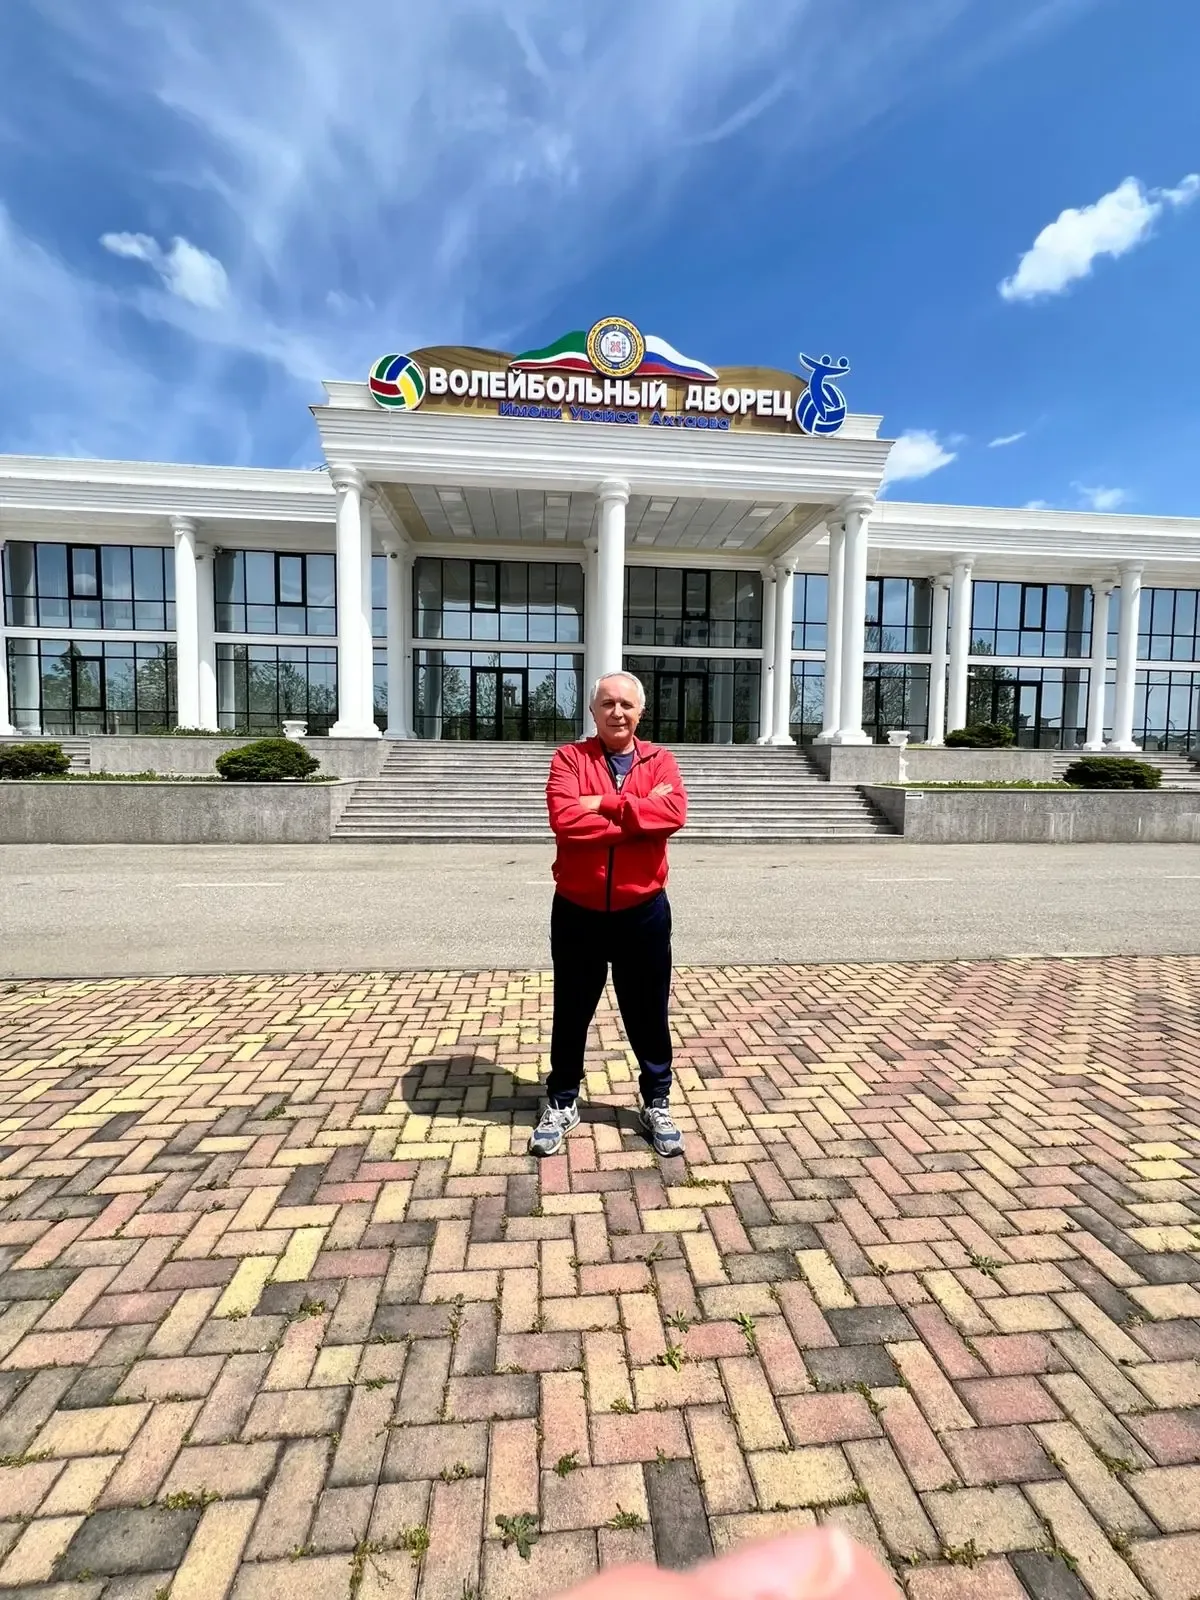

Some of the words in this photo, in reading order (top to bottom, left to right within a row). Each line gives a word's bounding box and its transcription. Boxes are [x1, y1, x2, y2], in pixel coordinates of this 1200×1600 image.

[429, 367, 668, 409] ВОЛЕЙБОЛЬНЫЙ
[685, 384, 793, 422] ДВОРЕЦ
[500, 401, 563, 419] Имени
[570, 404, 640, 425] Увайса
[649, 410, 731, 431] Ахтаева
